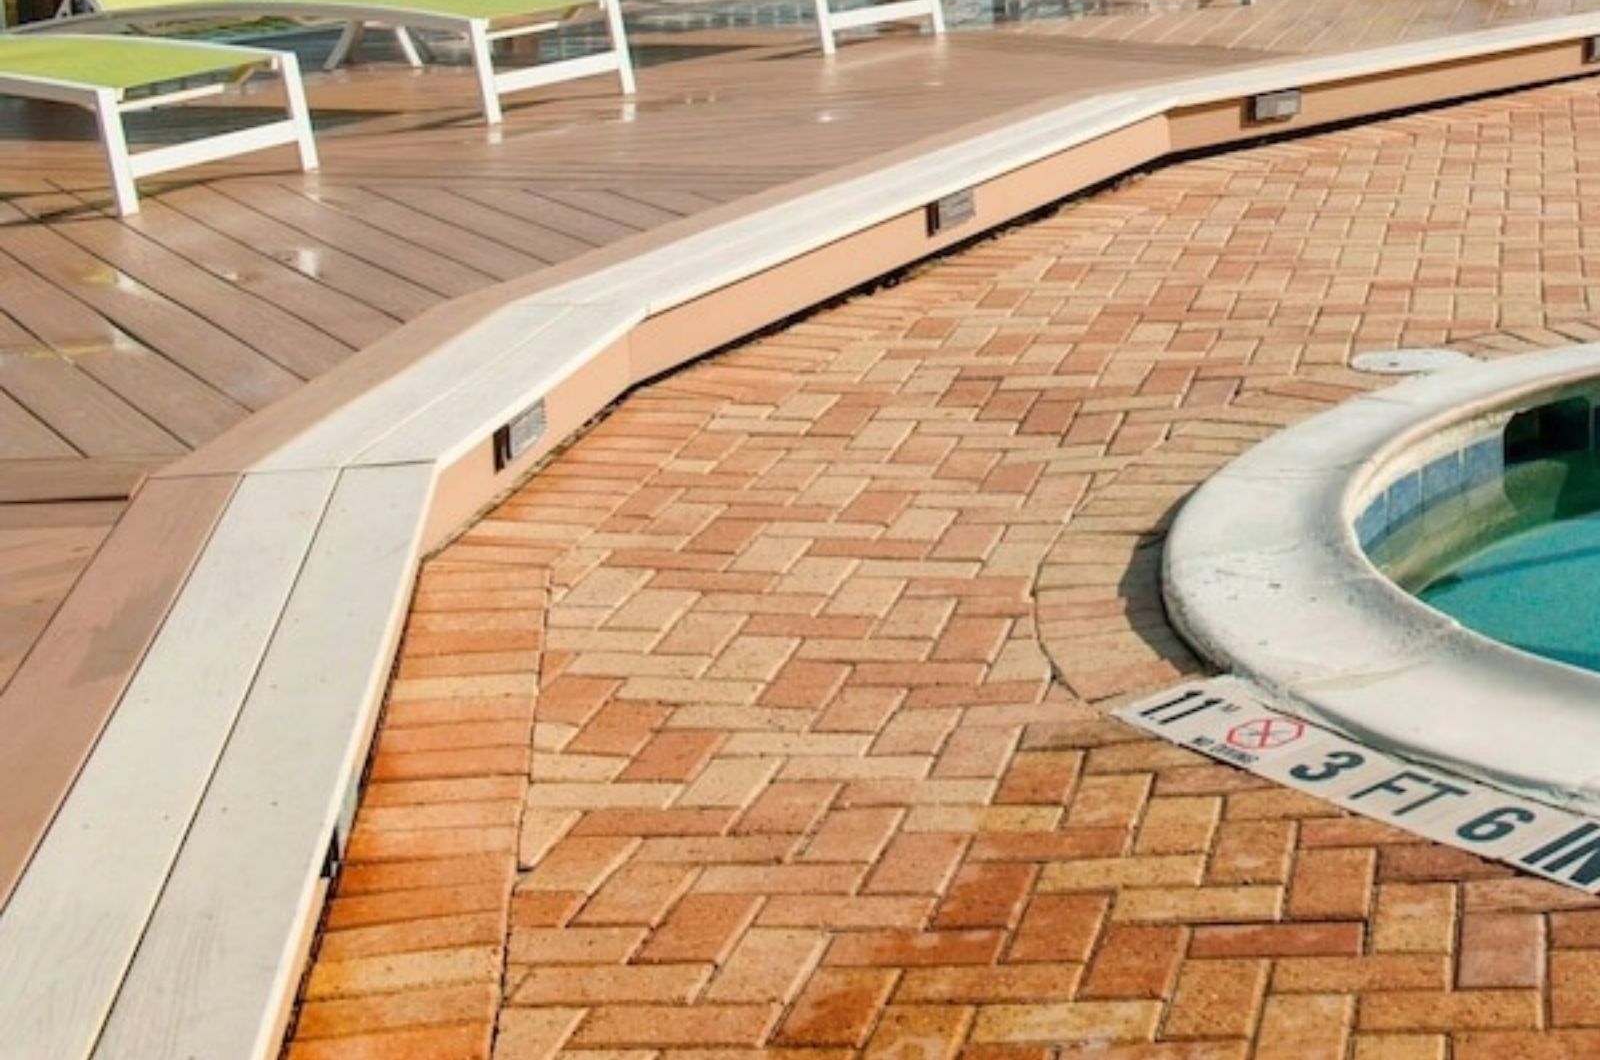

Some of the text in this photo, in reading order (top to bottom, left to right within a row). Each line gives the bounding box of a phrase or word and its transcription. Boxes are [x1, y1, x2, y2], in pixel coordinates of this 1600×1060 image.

[1289, 749, 1366, 784] 3
[1349, 770, 1470, 817] FT
[1456, 805, 1536, 842] 6
